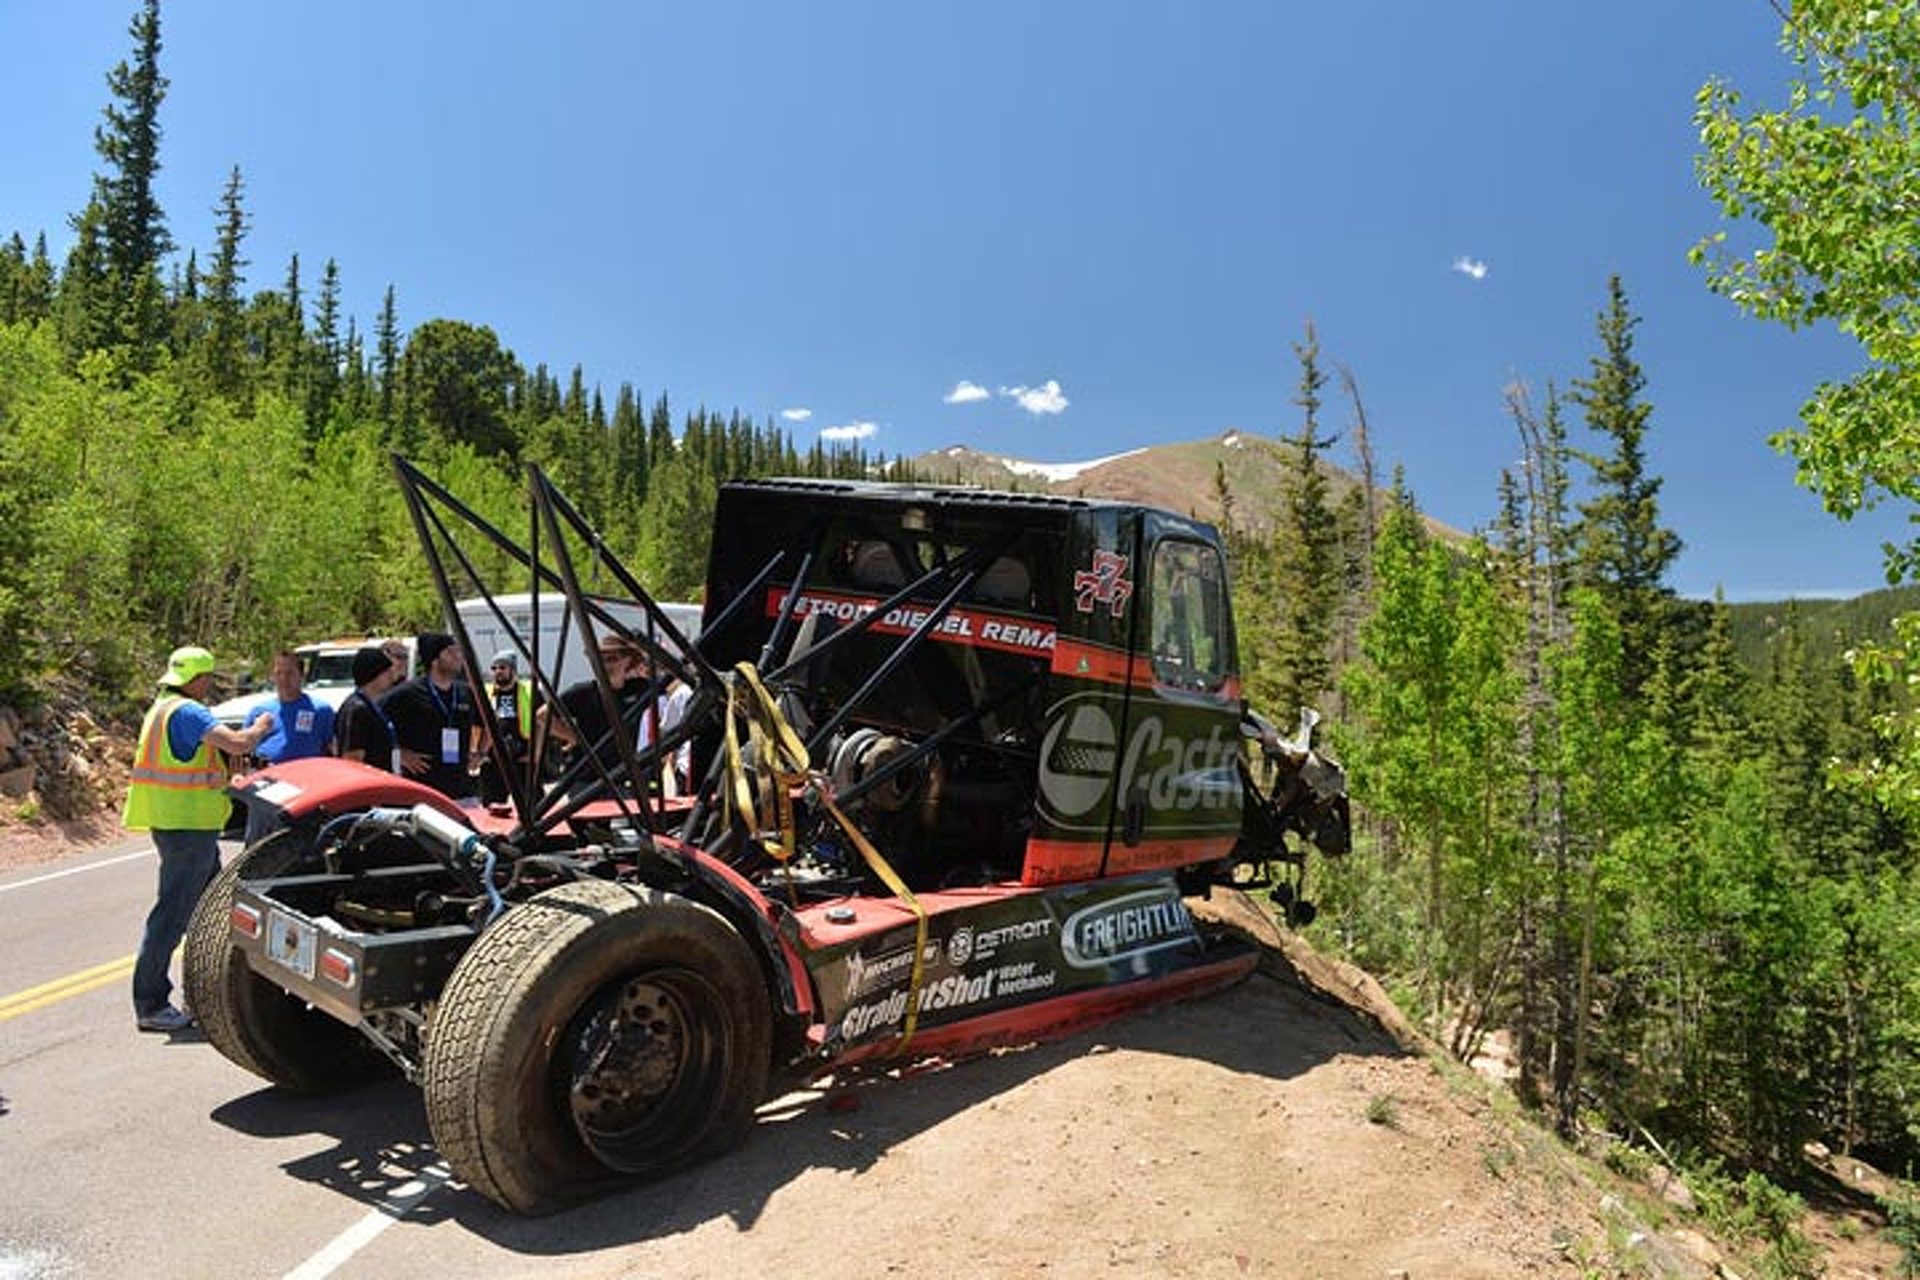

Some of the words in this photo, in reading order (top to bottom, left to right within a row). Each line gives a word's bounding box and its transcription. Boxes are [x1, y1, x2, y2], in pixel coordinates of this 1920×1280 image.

[884, 608, 974, 636] DIEEL
[981, 621, 1057, 650] REMA
[1117, 716, 1244, 812] Castr
[975, 919, 1053, 949] DETROIT
[997, 970, 1057, 996] Methanol
[999, 961, 1036, 980] Water
[841, 967, 993, 1041] StraigtShot
